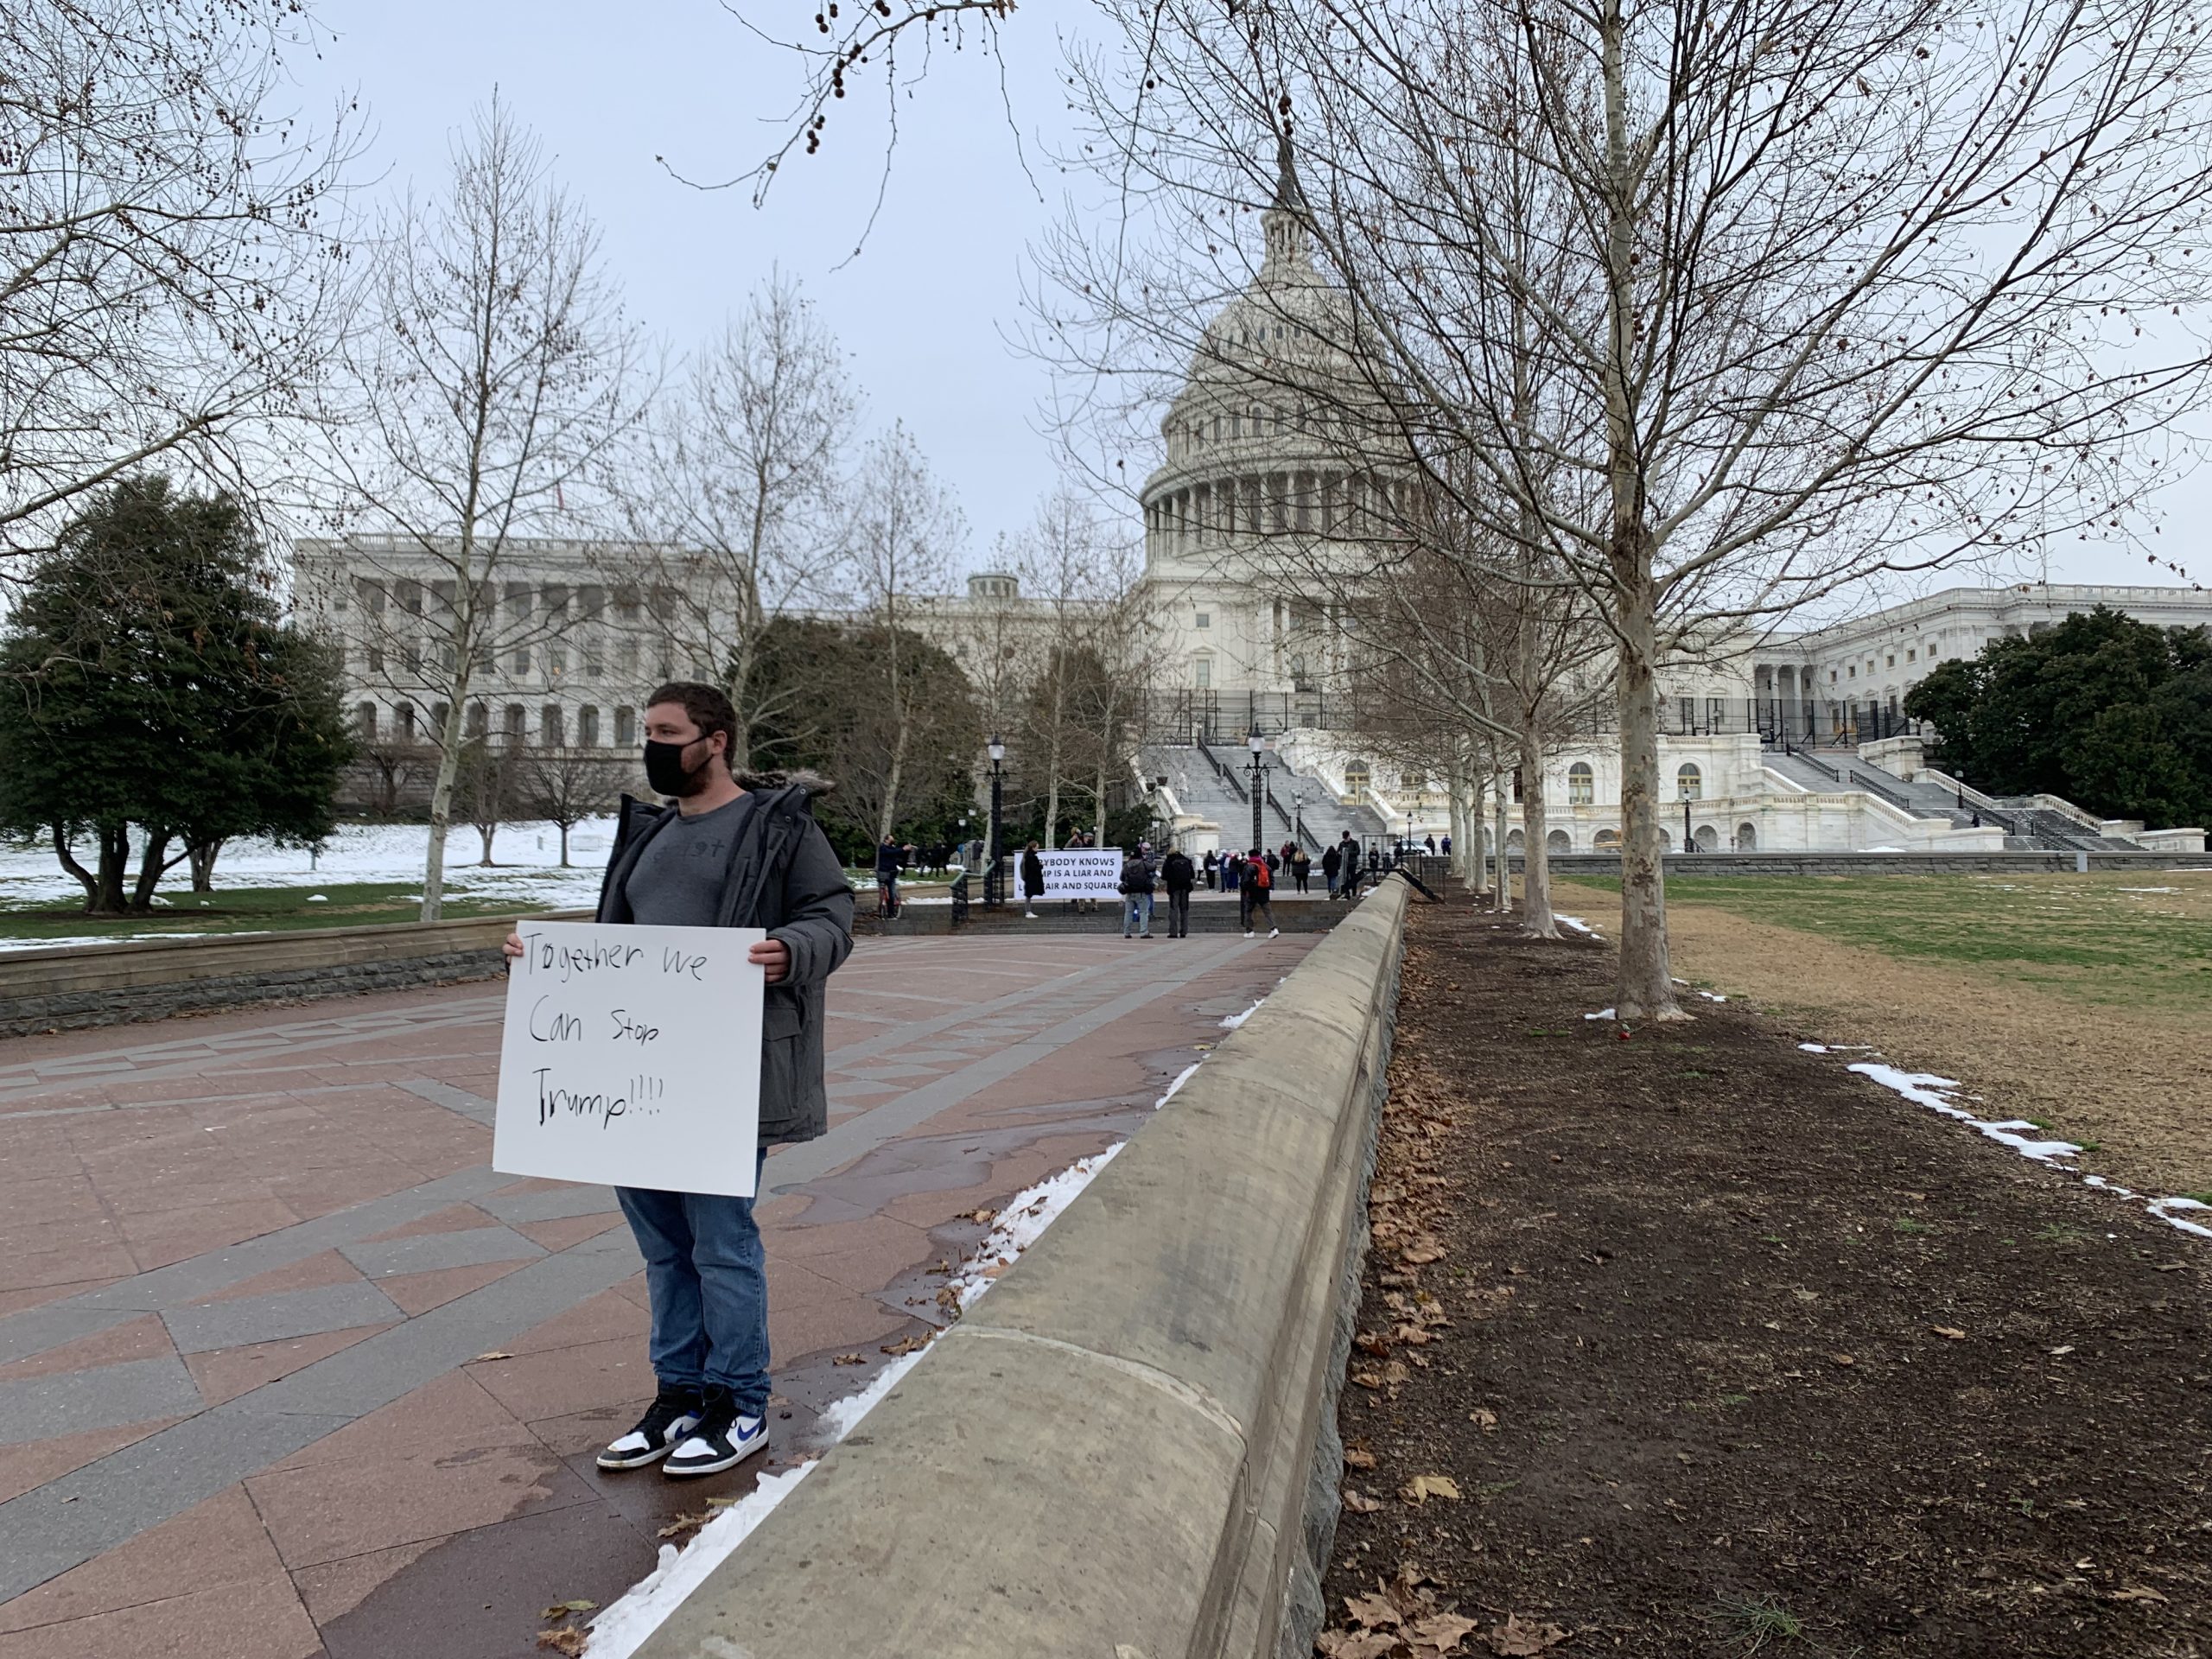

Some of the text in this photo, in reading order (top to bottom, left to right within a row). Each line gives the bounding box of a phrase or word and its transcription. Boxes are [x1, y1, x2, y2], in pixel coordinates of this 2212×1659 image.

[1039, 858, 1077, 867] RYBODY
[1084, 881, 1118, 890] SQUARE
[523, 932, 644, 983] Together
[529, 995, 659, 1046] Can Stop
[532, 1067, 664, 1130] Trump!!!!
